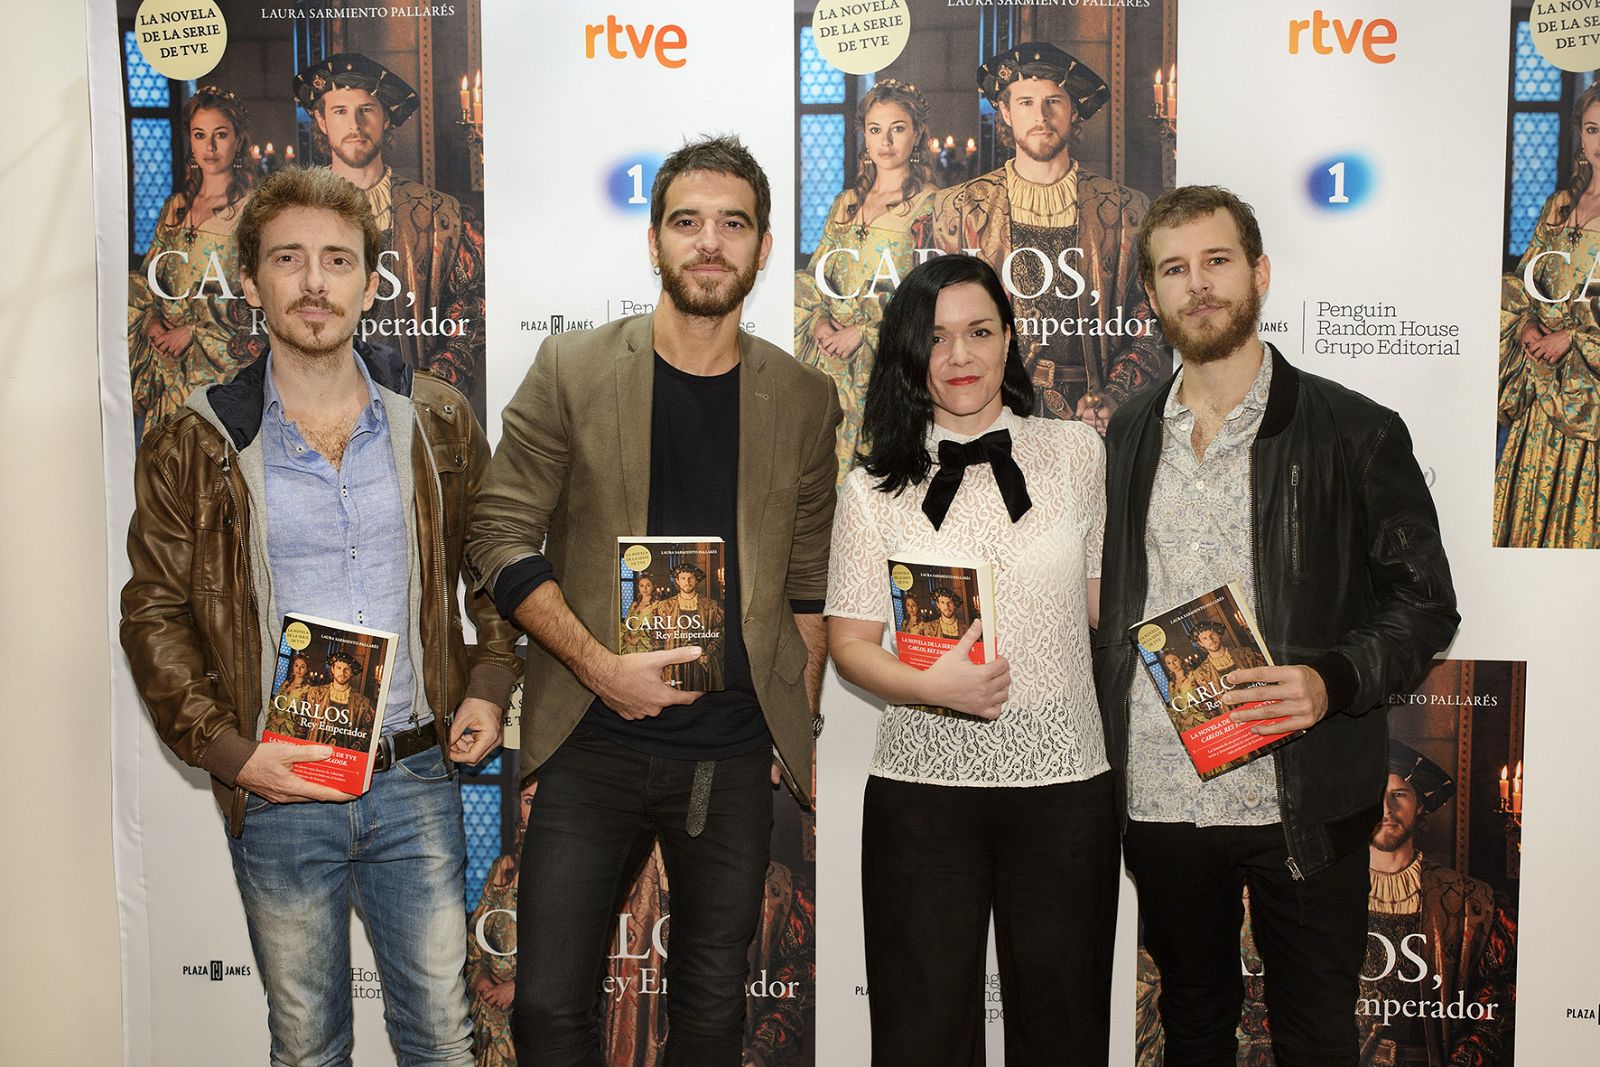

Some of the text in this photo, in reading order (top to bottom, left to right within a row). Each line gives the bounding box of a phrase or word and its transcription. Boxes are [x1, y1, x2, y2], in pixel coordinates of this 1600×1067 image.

[140, 8, 216, 26] LA NOVELA
[261, 4, 455, 20] LAURA SARMIENTO PALLARÉS
[819, 0, 900, 21] LA NOVELA
[1538, 4, 1557, 14] LA
[142, 24, 221, 44] DE LA SERIE
[820, 16, 904, 38] DE LA SERIE
[1538, 22, 1558, 33] DE
[1561, 19, 1580, 30] LA
[585, 14, 688, 68] rtve
[838, 36, 890, 53] DE TVE
[1288, 10, 1398, 64] rtve
[1556, 38, 1576, 49] DE
[160, 43, 209, 59] DE TVE
[814, 248, 1100, 305] CAOS,
[1317, 302, 1396, 321] Penguin
[520, 320, 548, 330] PLAZA
[1013, 306, 1157, 346] mperador
[1258, 320, 1288, 332] JANÉS
[1316, 321, 1460, 337] Random House
[1315, 339, 1460, 358] Grupo Editorial
[626, 614, 704, 631] CARLOS,
[656, 629, 720, 641] Rey Emperador
[1430, 694, 1498, 706] PALLARÉS
[274, 694, 352, 727] CARLOS,
[300, 717, 368, 740] Rey Emperador
[1198, 723, 1222, 736] NOVELA
[182, 964, 251, 976] PLAZA JANÉS
[351, 968, 382, 983] Hou
[602, 975, 632, 1002] ey
[1355, 990, 1498, 1026] mperador
[1566, 1008, 1595, 1019] PLAZA
